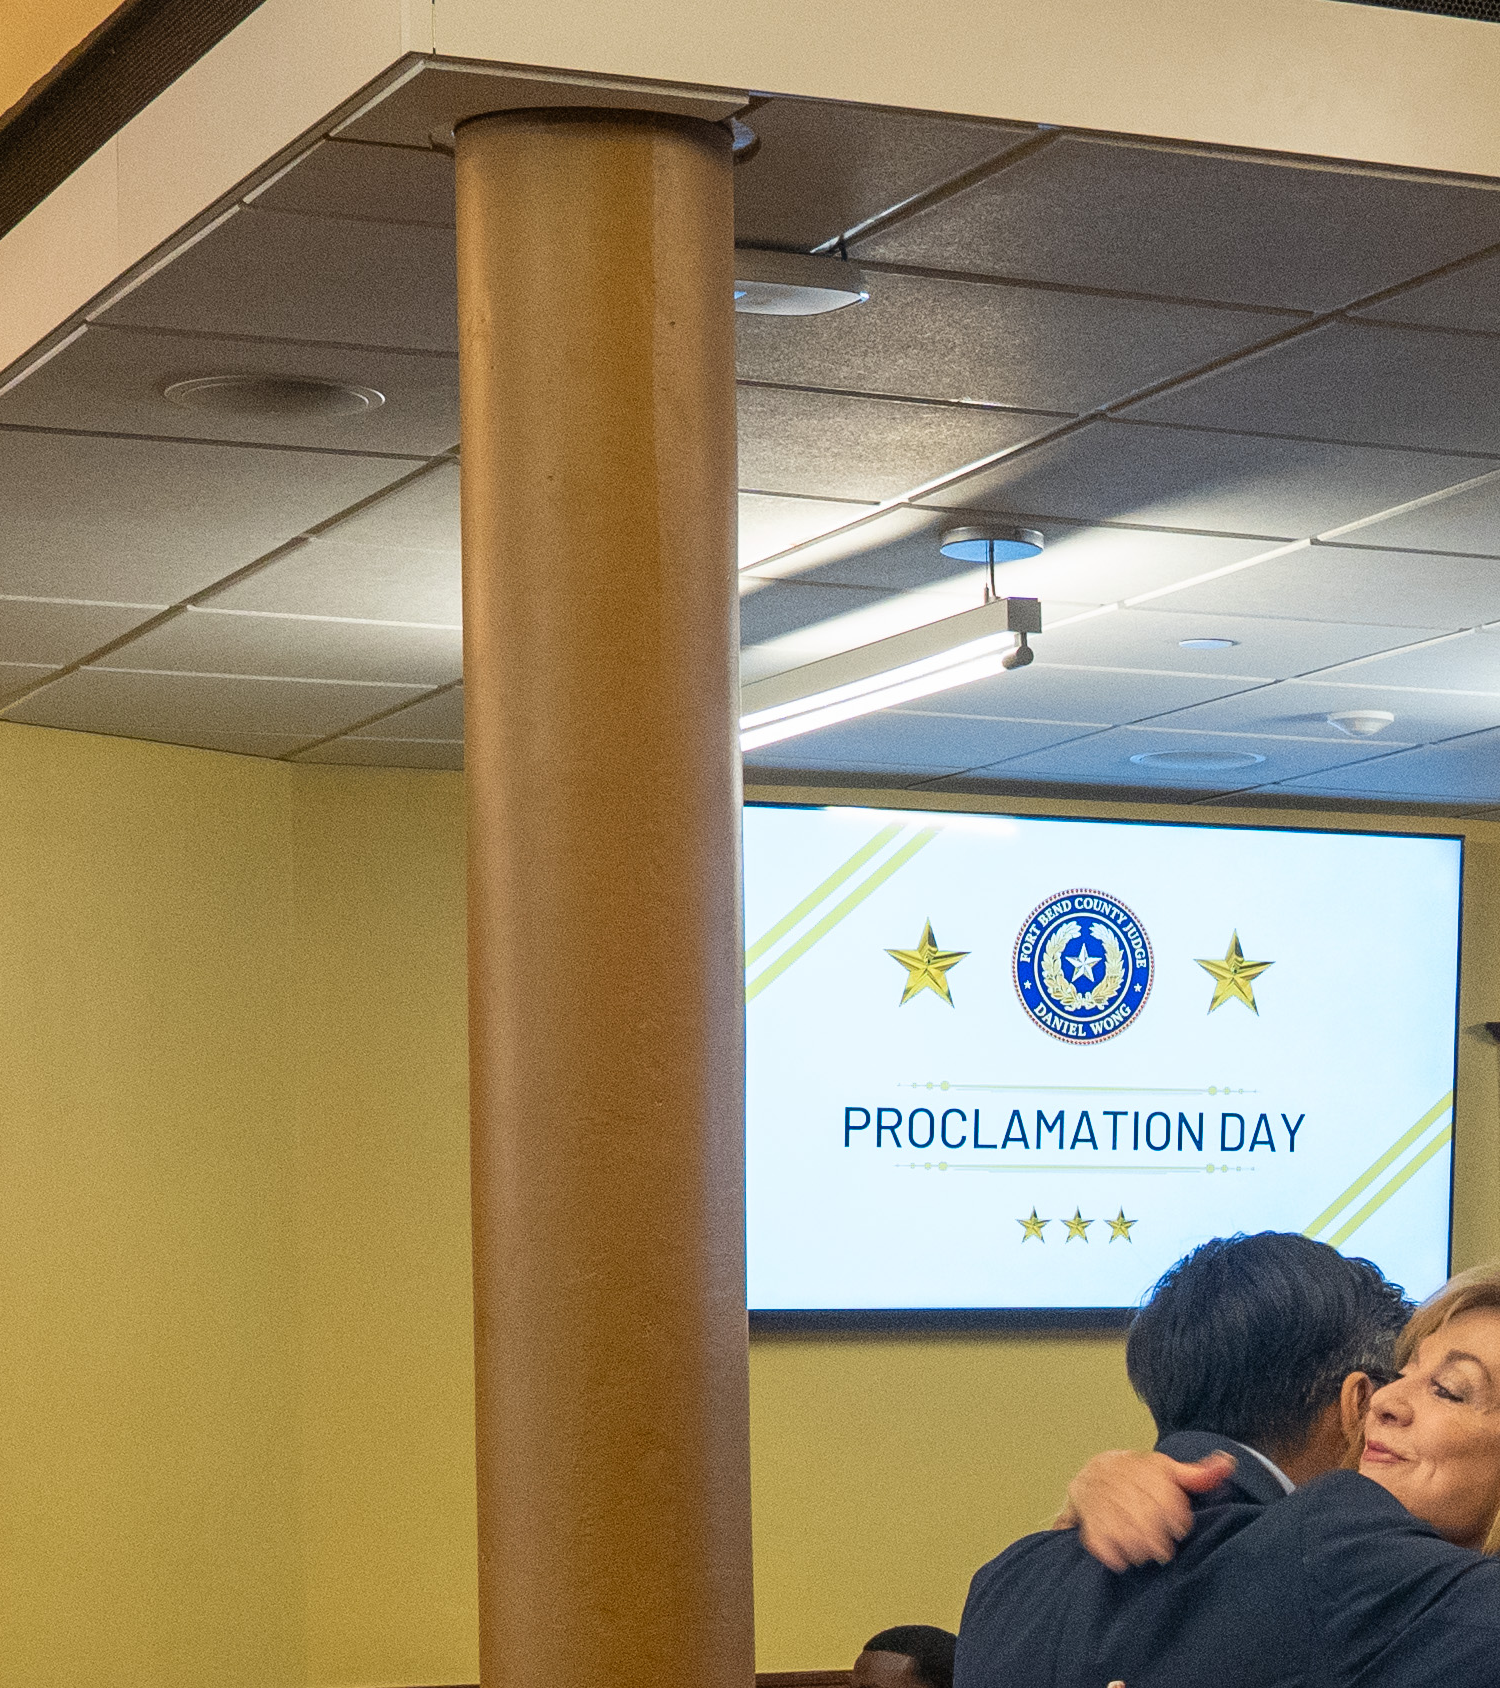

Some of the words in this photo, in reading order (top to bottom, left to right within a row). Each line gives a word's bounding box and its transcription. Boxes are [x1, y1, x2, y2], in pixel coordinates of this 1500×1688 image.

[1020, 924, 1041, 963] FORT
[1037, 899, 1072, 927] BEND
[1074, 897, 1128, 924] COUNTY
[1124, 922, 1147, 968] JUDGE
[1034, 1002, 1087, 1036] DANIEL
[1090, 1003, 1132, 1035] WONG
[843, 1106, 1204, 1151] PROCLAMATION
[1220, 1112, 1306, 1153] DAY
